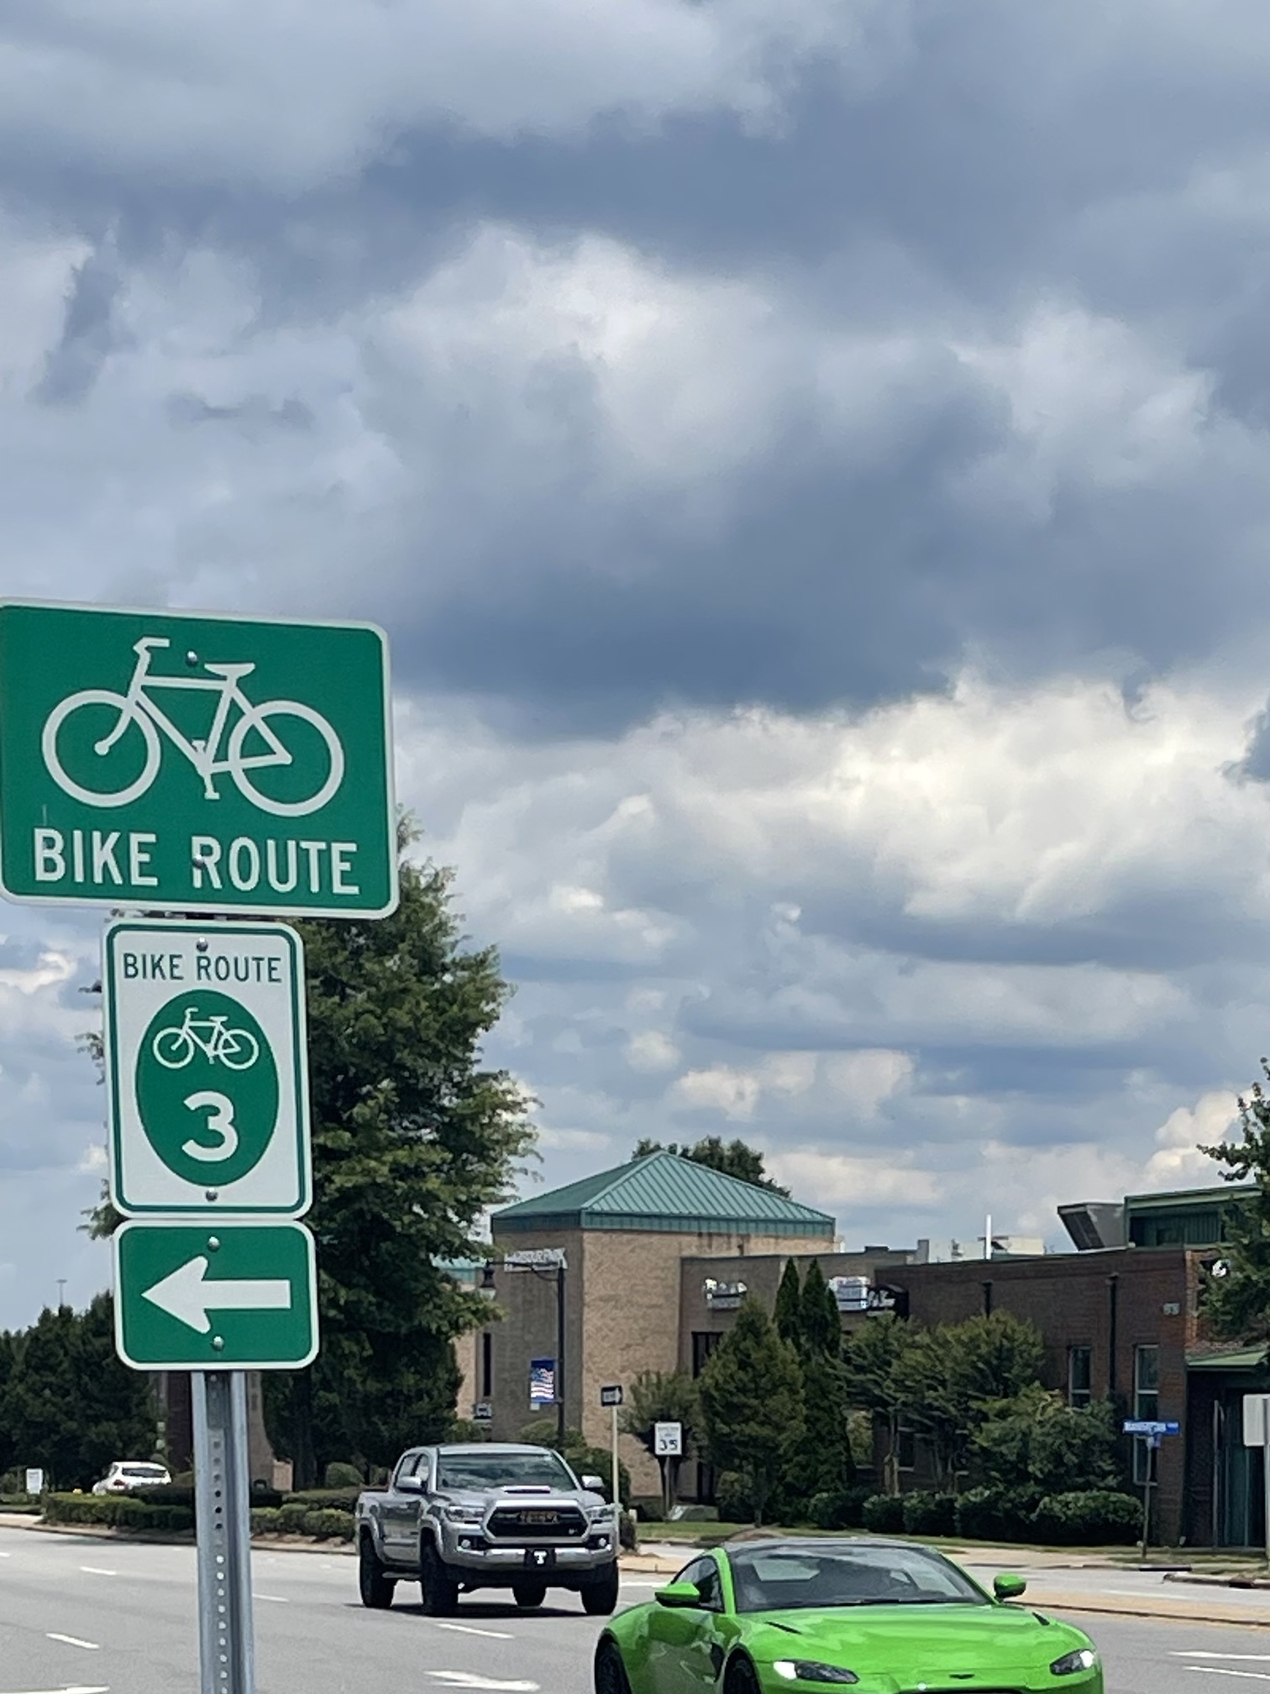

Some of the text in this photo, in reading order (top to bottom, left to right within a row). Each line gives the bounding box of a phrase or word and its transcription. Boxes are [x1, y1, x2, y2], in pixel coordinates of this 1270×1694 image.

[34, 827, 360, 895] BIKE ROUTE
[123, 953, 282, 983] BIKE ROUTE
[181, 1090, 239, 1162] 3
